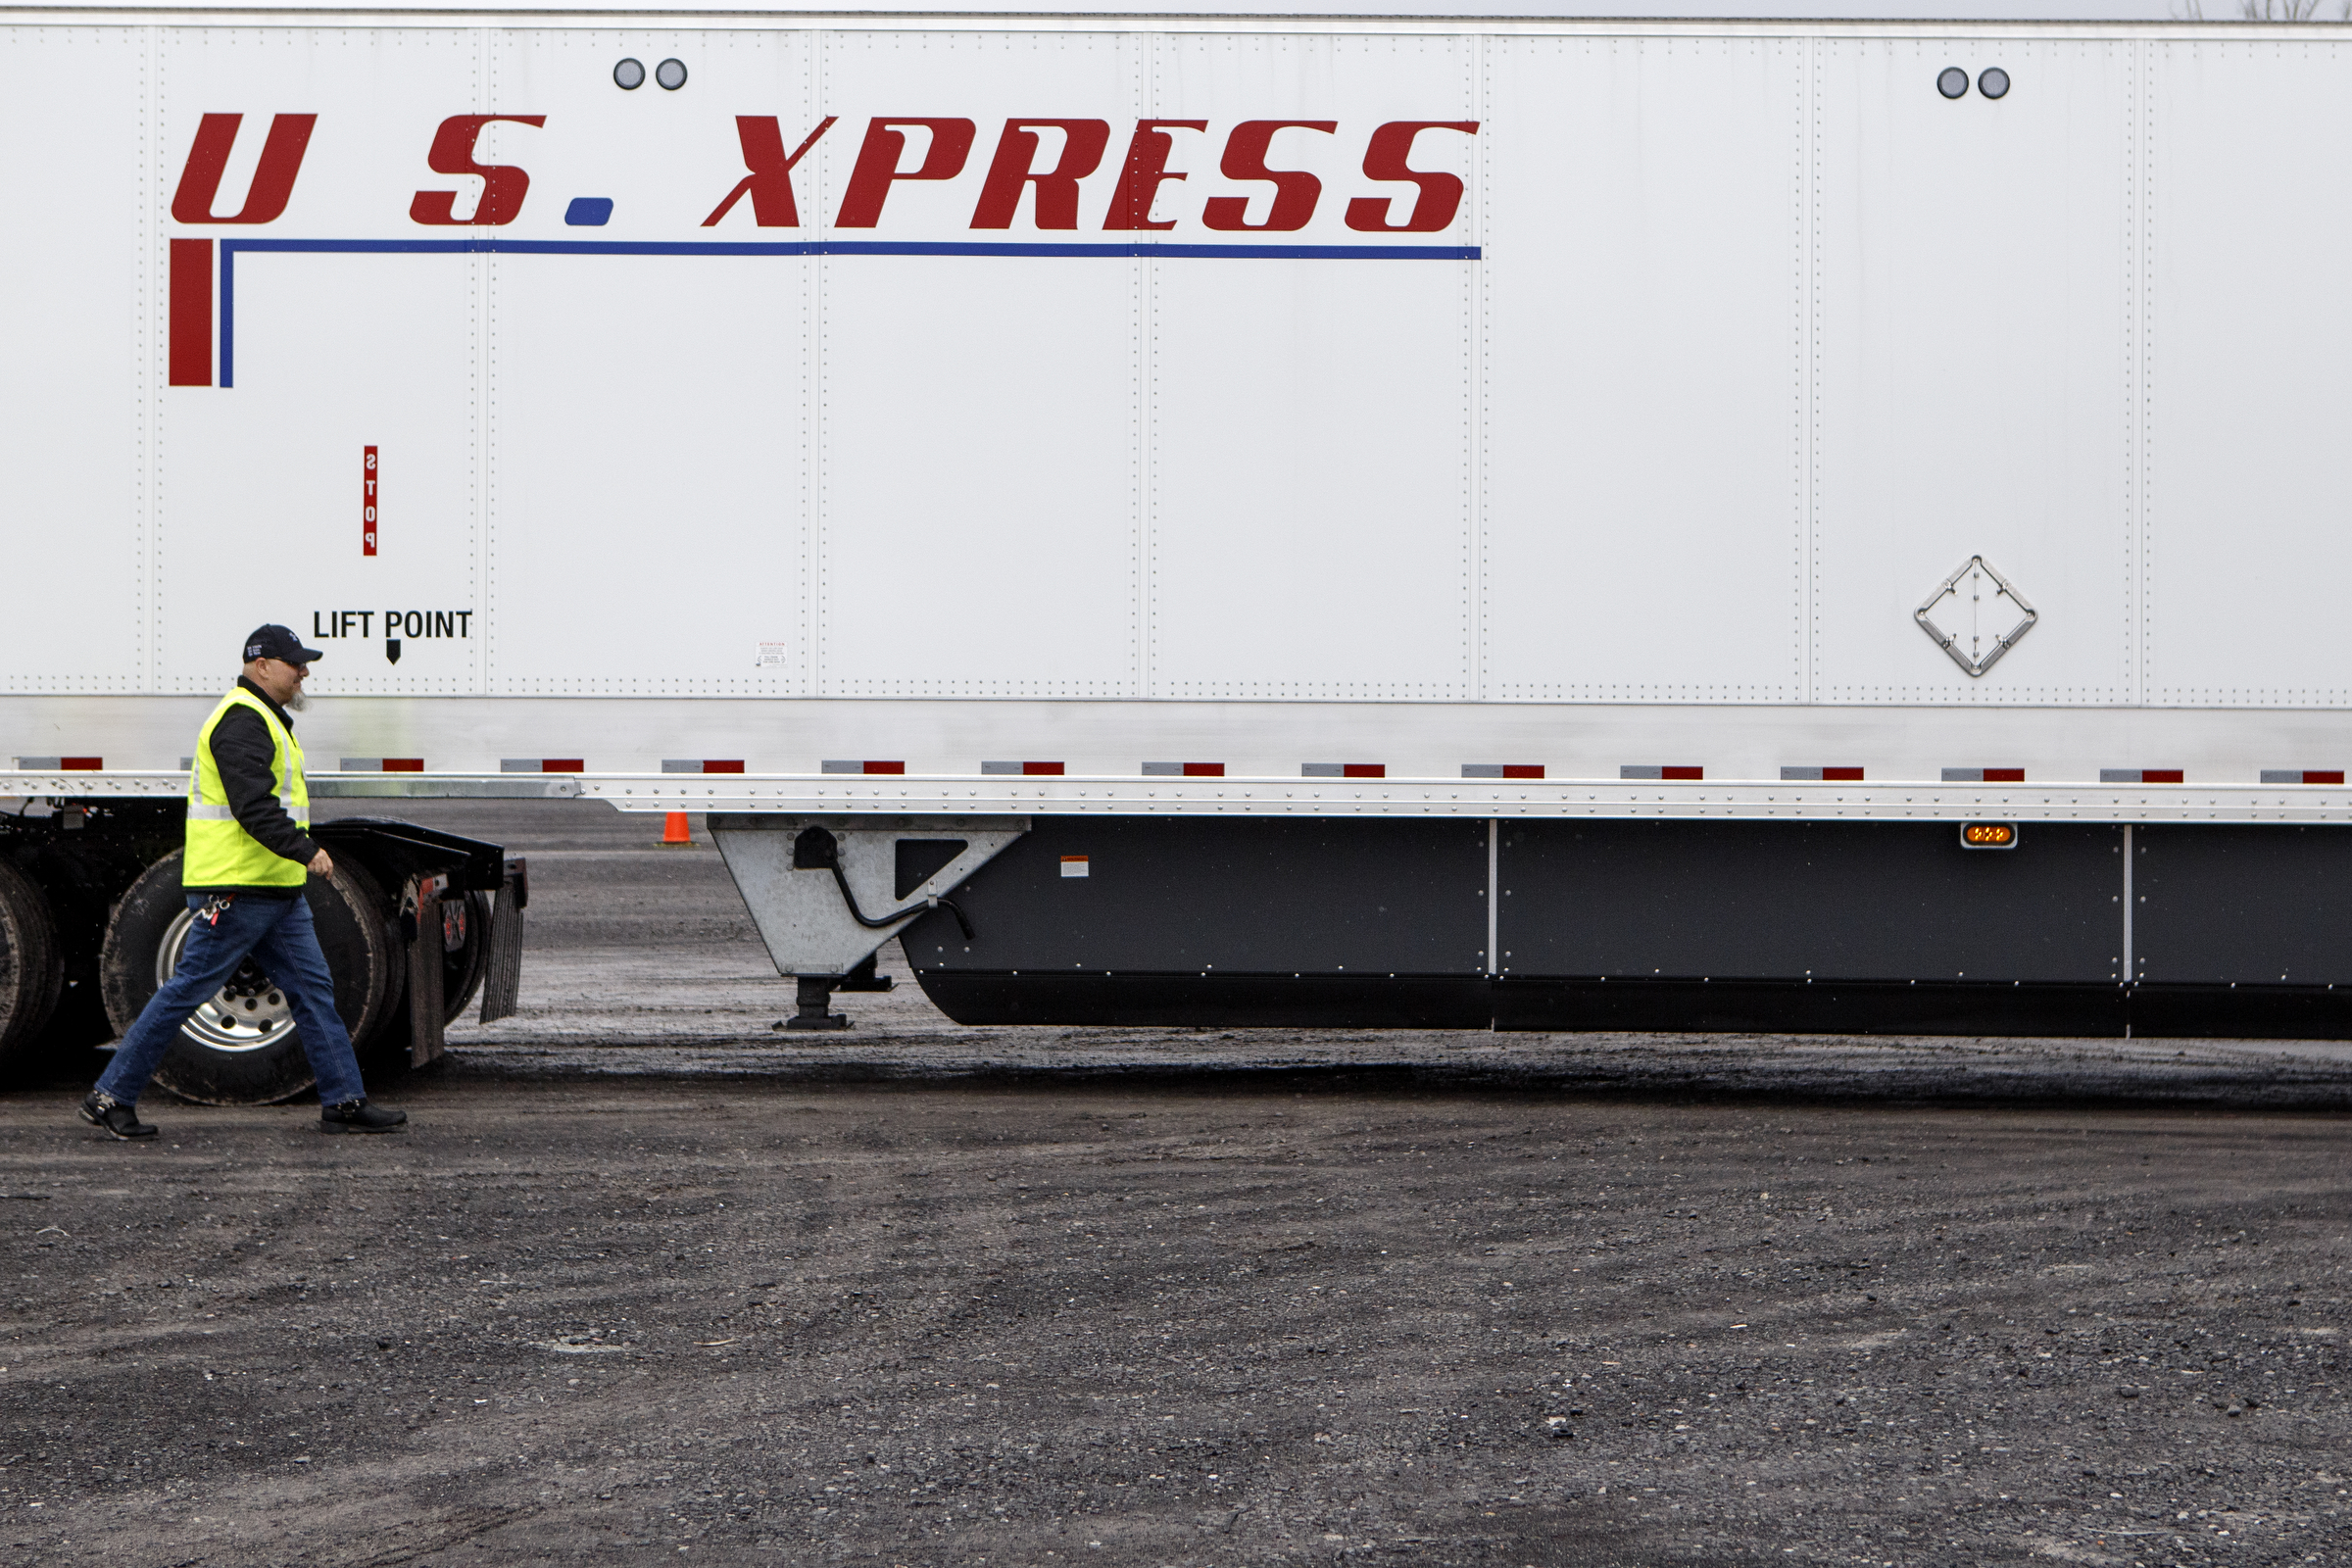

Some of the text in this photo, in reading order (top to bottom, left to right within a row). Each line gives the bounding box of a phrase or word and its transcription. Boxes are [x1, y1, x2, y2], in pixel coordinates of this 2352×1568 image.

[701, 117, 1480, 232] XPRESS
[314, 611, 473, 638] LIFT POINT
